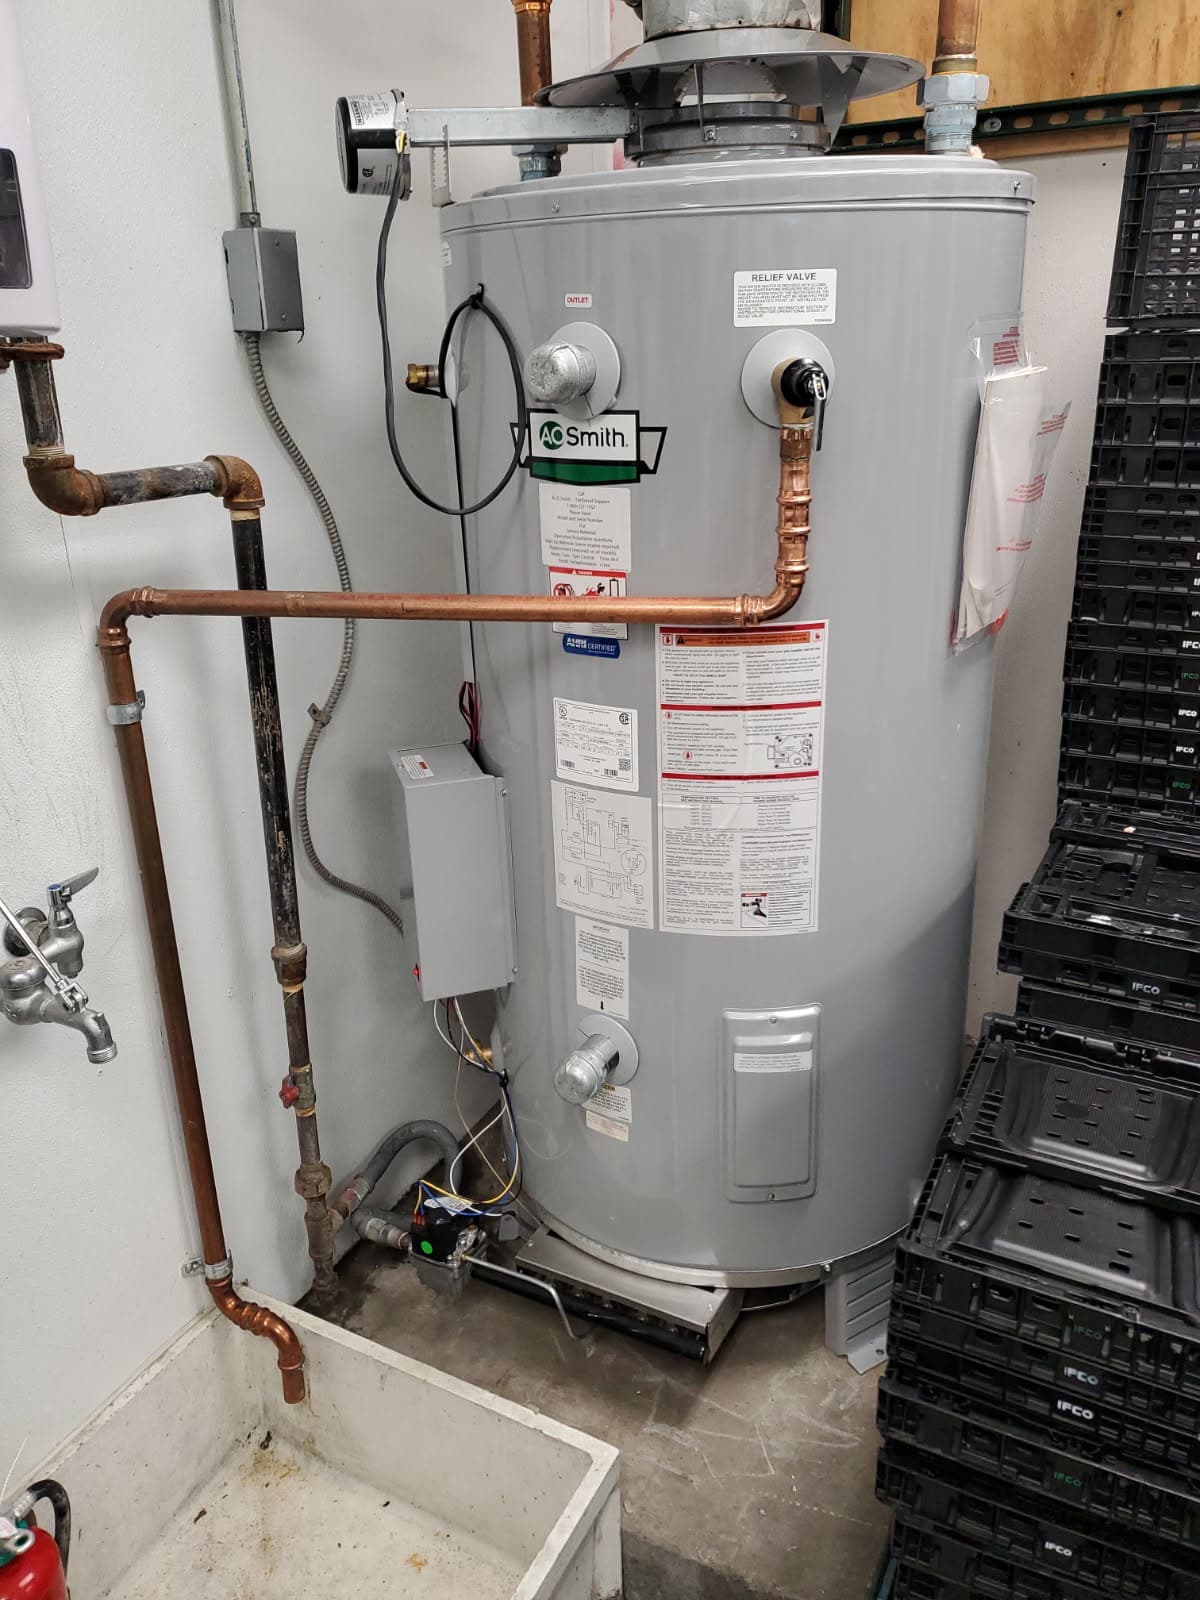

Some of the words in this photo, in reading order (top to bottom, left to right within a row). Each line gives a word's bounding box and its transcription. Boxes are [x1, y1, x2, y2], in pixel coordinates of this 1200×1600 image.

[751, 273, 784, 282] RELIEF
[786, 272, 817, 281] VALVE
[567, 296, 589, 304] OUTLET
[566, 427, 625, 447] Smith
[587, 642, 617, 652] CERTIFIED
[1181, 671, 1200, 680] IFCO
[1178, 709, 1197, 717] IFCO
[1176, 746, 1194, 754] IFCO
[1172, 781, 1190, 789] IFCO
[1132, 981, 1160, 993] IFCO
[1073, 1323, 1103, 1341] IFCO
[1063, 1366, 1100, 1386] IFCO
[1056, 1399, 1095, 1421] IFCO
[1054, 1471, 1082, 1488] IFCO
[1044, 1541, 1073, 1557] IFCO
